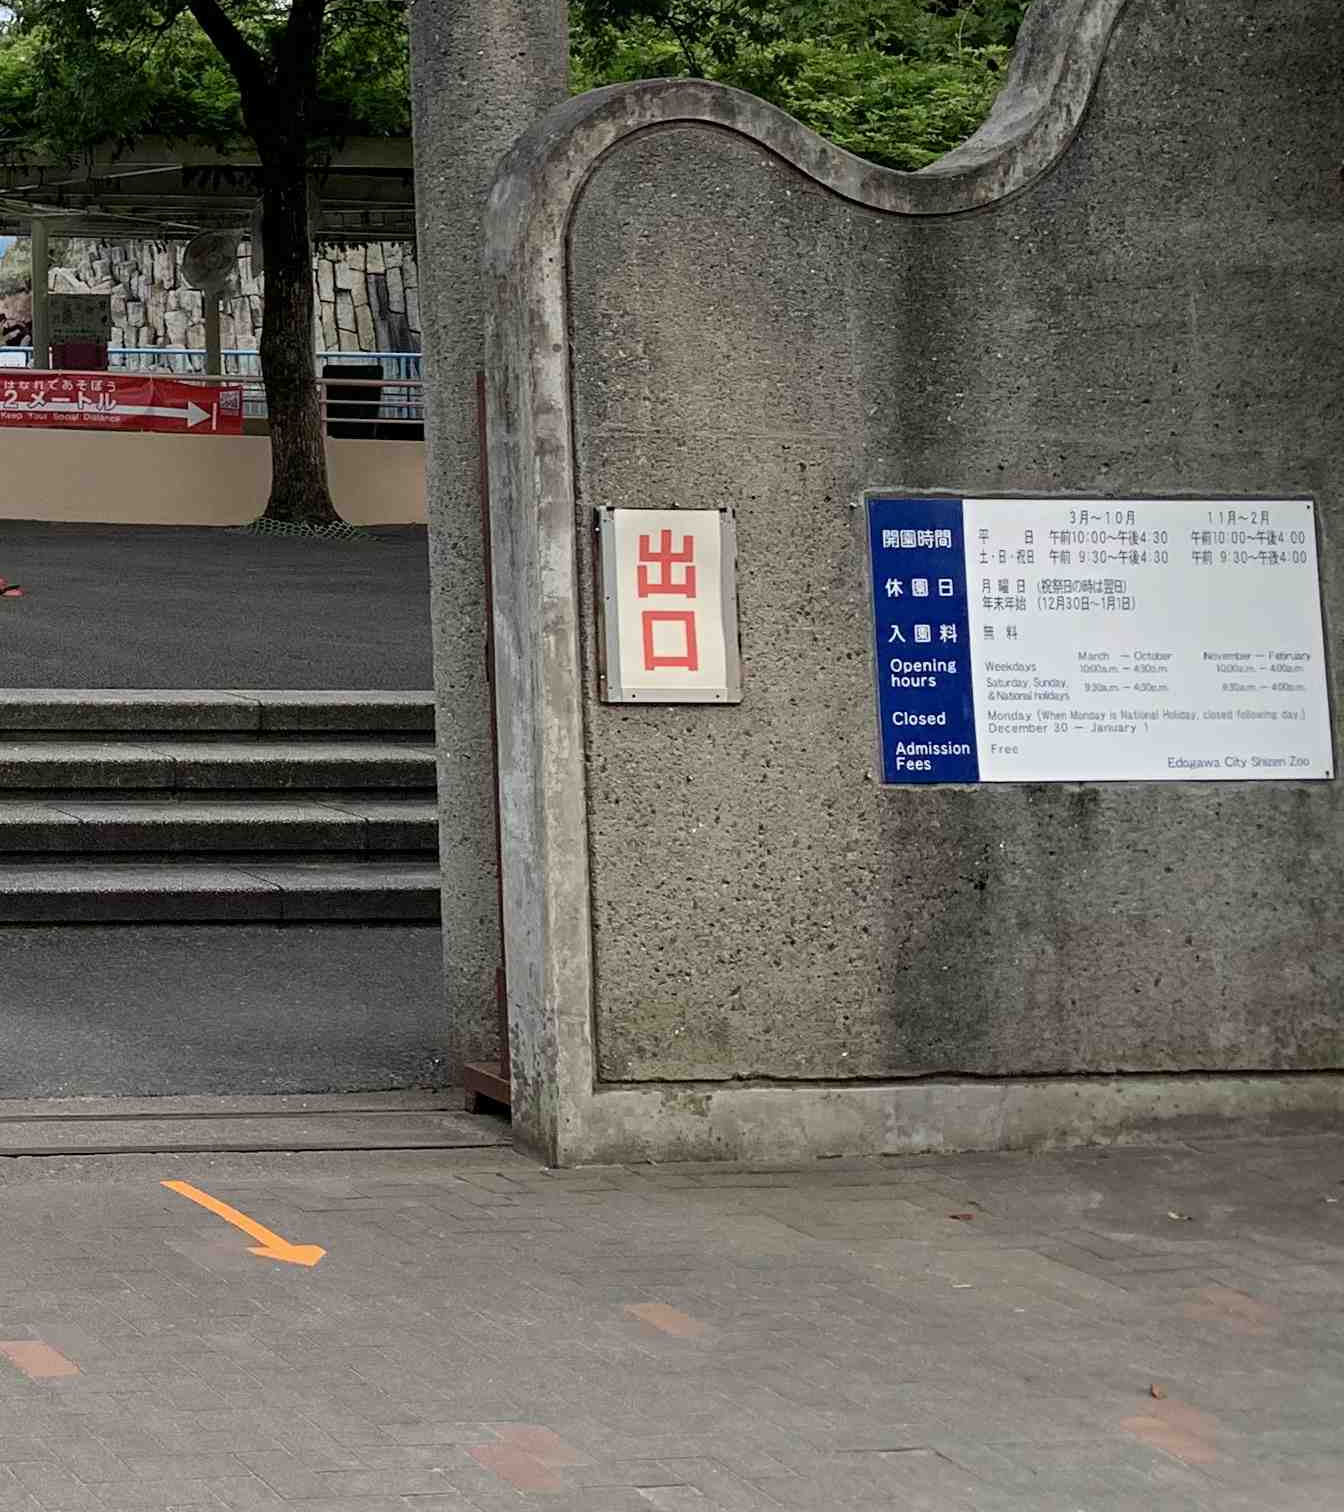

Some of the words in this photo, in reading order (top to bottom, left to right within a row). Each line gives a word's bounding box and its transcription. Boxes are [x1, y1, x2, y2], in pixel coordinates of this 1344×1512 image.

[3, 379, 116, 393] はなれてあそぼう
[3, 389, 117, 410] 2メートル
[882, 530, 952, 548] 開園時間
[885, 578, 953, 597] 休園日
[637, 529, 698, 671] 出口
[982, 595, 1026, 611] 年末年始
[888, 623, 958, 643] 入園料
[1078, 650, 1110, 661] March
[1133, 650, 1173, 661] October
[1203, 650, 1251, 661] November
[1268, 650, 1310, 662] February
[890, 658, 957, 674] Opening
[984, 661, 1037, 672] Weekdays
[892, 675, 937, 688] hours
[997, 690, 1032, 701] National
[892, 711, 946, 725] Closed
[987, 709, 1033, 721] Monday
[1037, 709, 1067, 721] (When
[1070, 709, 1106, 721] Monday
[1120, 709, 1159, 720] National
[1163, 709, 1199, 721] Holiday,
[1203, 709, 1233, 720] closed
[1237, 709, 1278, 721] following
[988, 723, 1049, 734] December
[1054, 723, 1069, 733] 30
[1090, 723, 1137, 734] January
[896, 741, 971, 756] Admission
[991, 744, 1020, 754] Free
[896, 757, 932, 771] Fees
[1167, 757, 1221, 769] Edogawa
[1224, 756, 1247, 768] City
[1251, 757, 1286, 767] Shizen
[1290, 756, 1310, 767] Zoo
